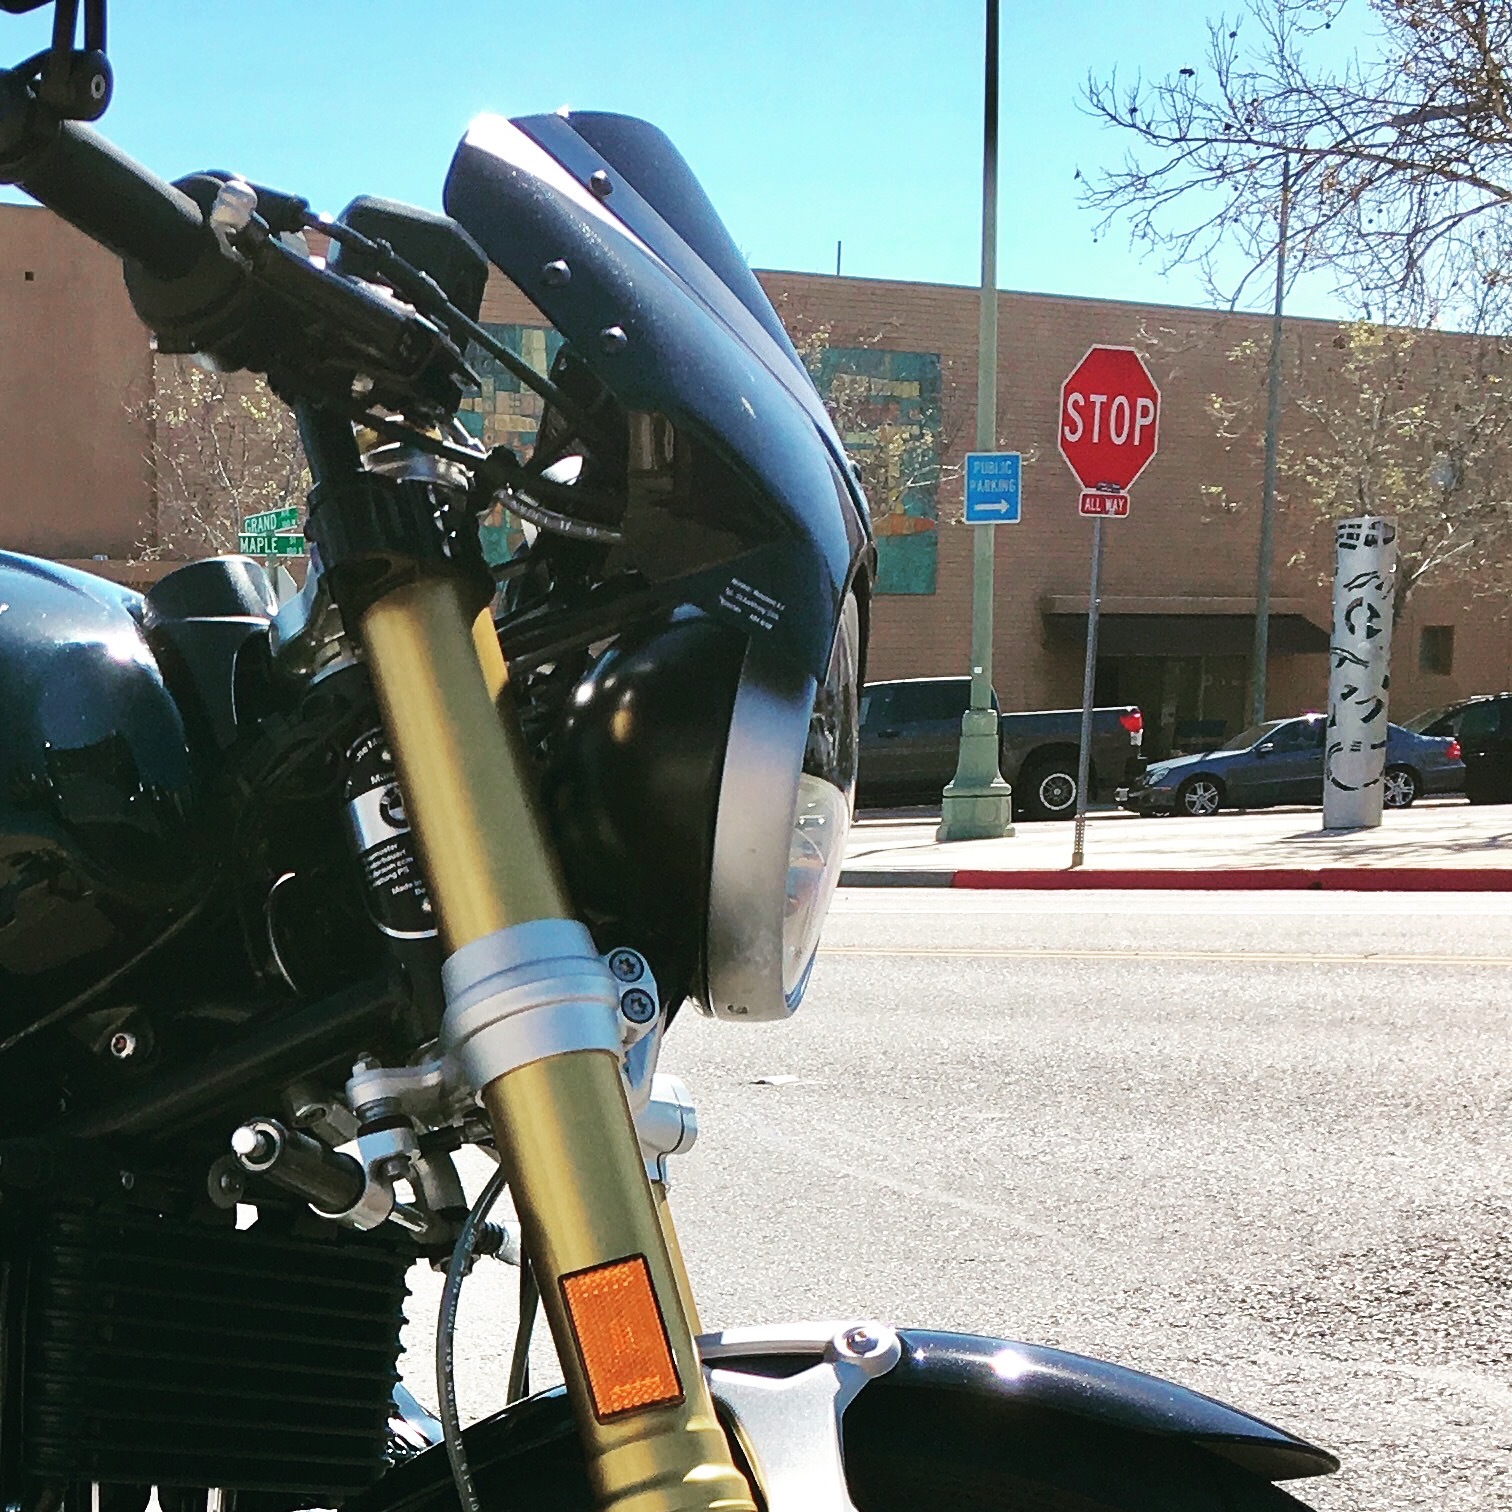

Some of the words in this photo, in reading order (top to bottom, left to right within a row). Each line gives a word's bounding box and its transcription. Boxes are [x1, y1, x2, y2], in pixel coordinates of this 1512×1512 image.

[1063, 391, 1156, 446] STOP
[972, 460, 1013, 475] PUBLIC
[969, 478, 1017, 493] PARKING
[1084, 498, 1101, 511] ALL
[1105, 498, 1125, 513] WAY
[245, 514, 276, 533] GRAND
[240, 537, 278, 553] MAPLE
